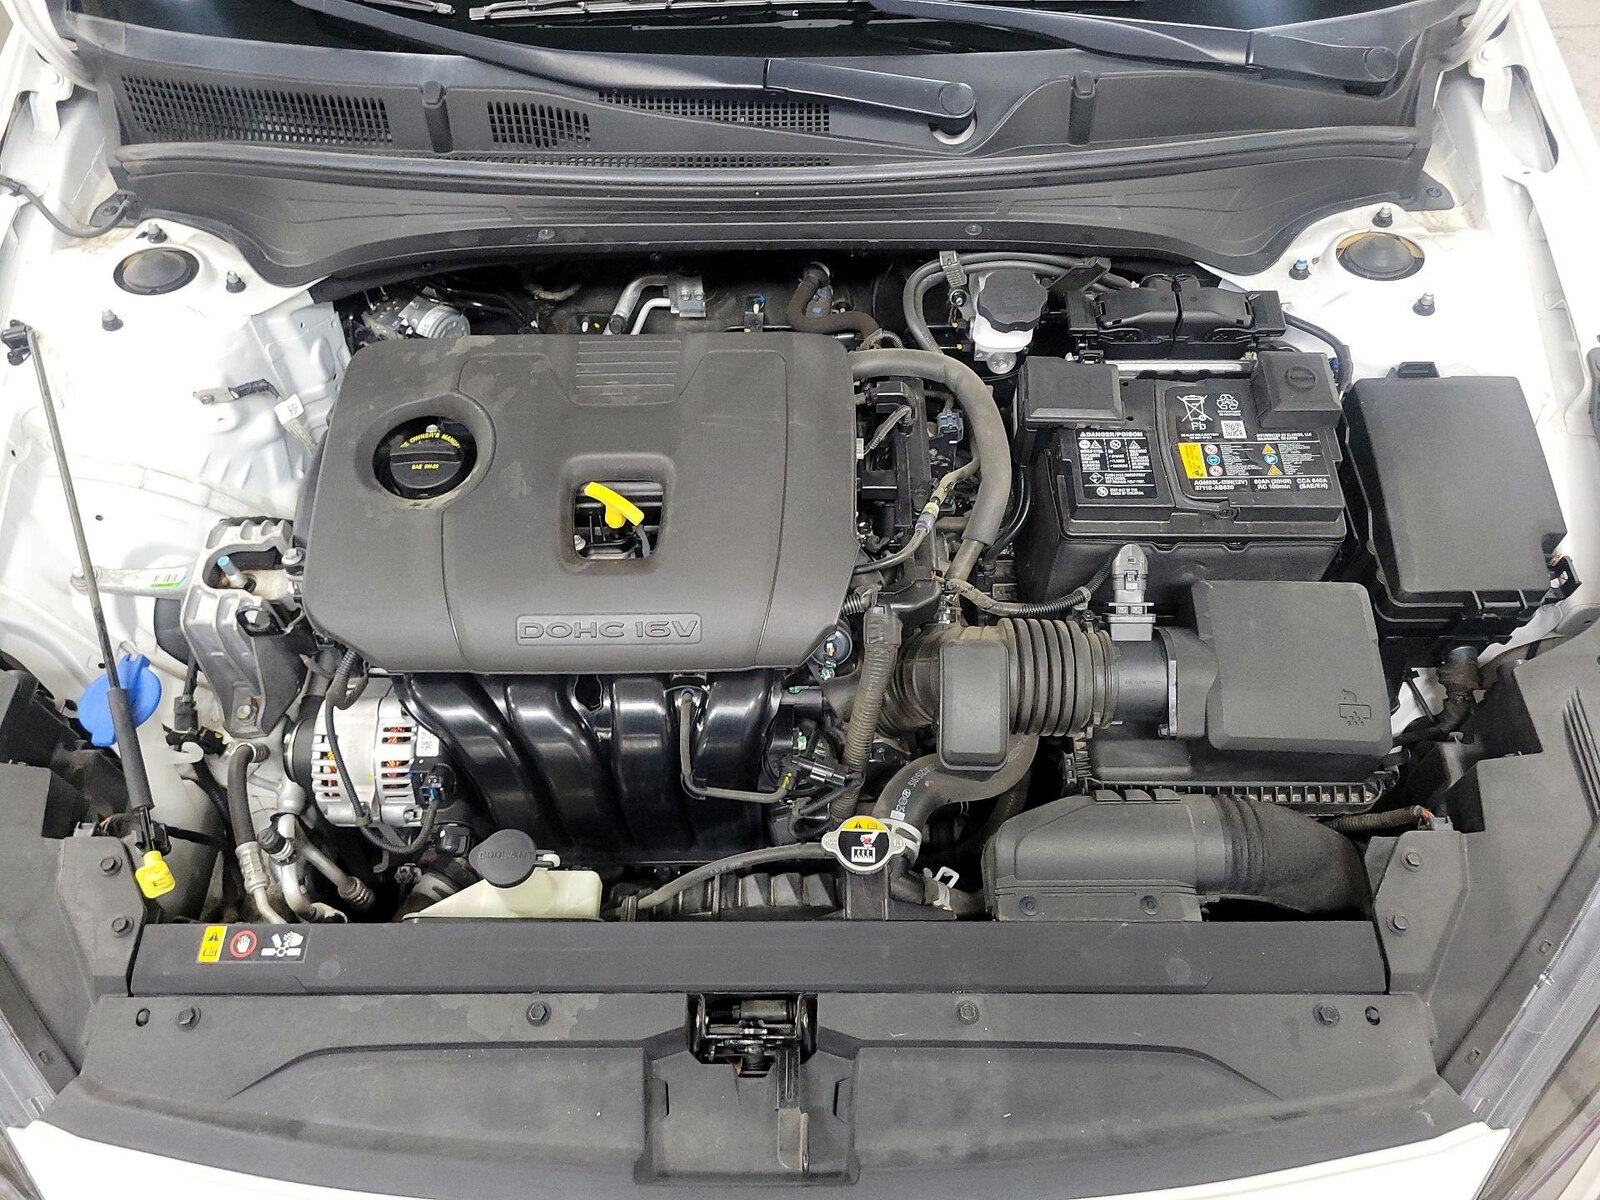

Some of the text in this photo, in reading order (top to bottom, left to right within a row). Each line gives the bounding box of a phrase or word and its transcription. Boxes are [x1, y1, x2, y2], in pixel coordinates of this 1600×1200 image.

[1191, 421, 1207, 430] Pb
[520, 620, 698, 639] DOHC 16V
[479, 850, 533, 860] COOLANT
